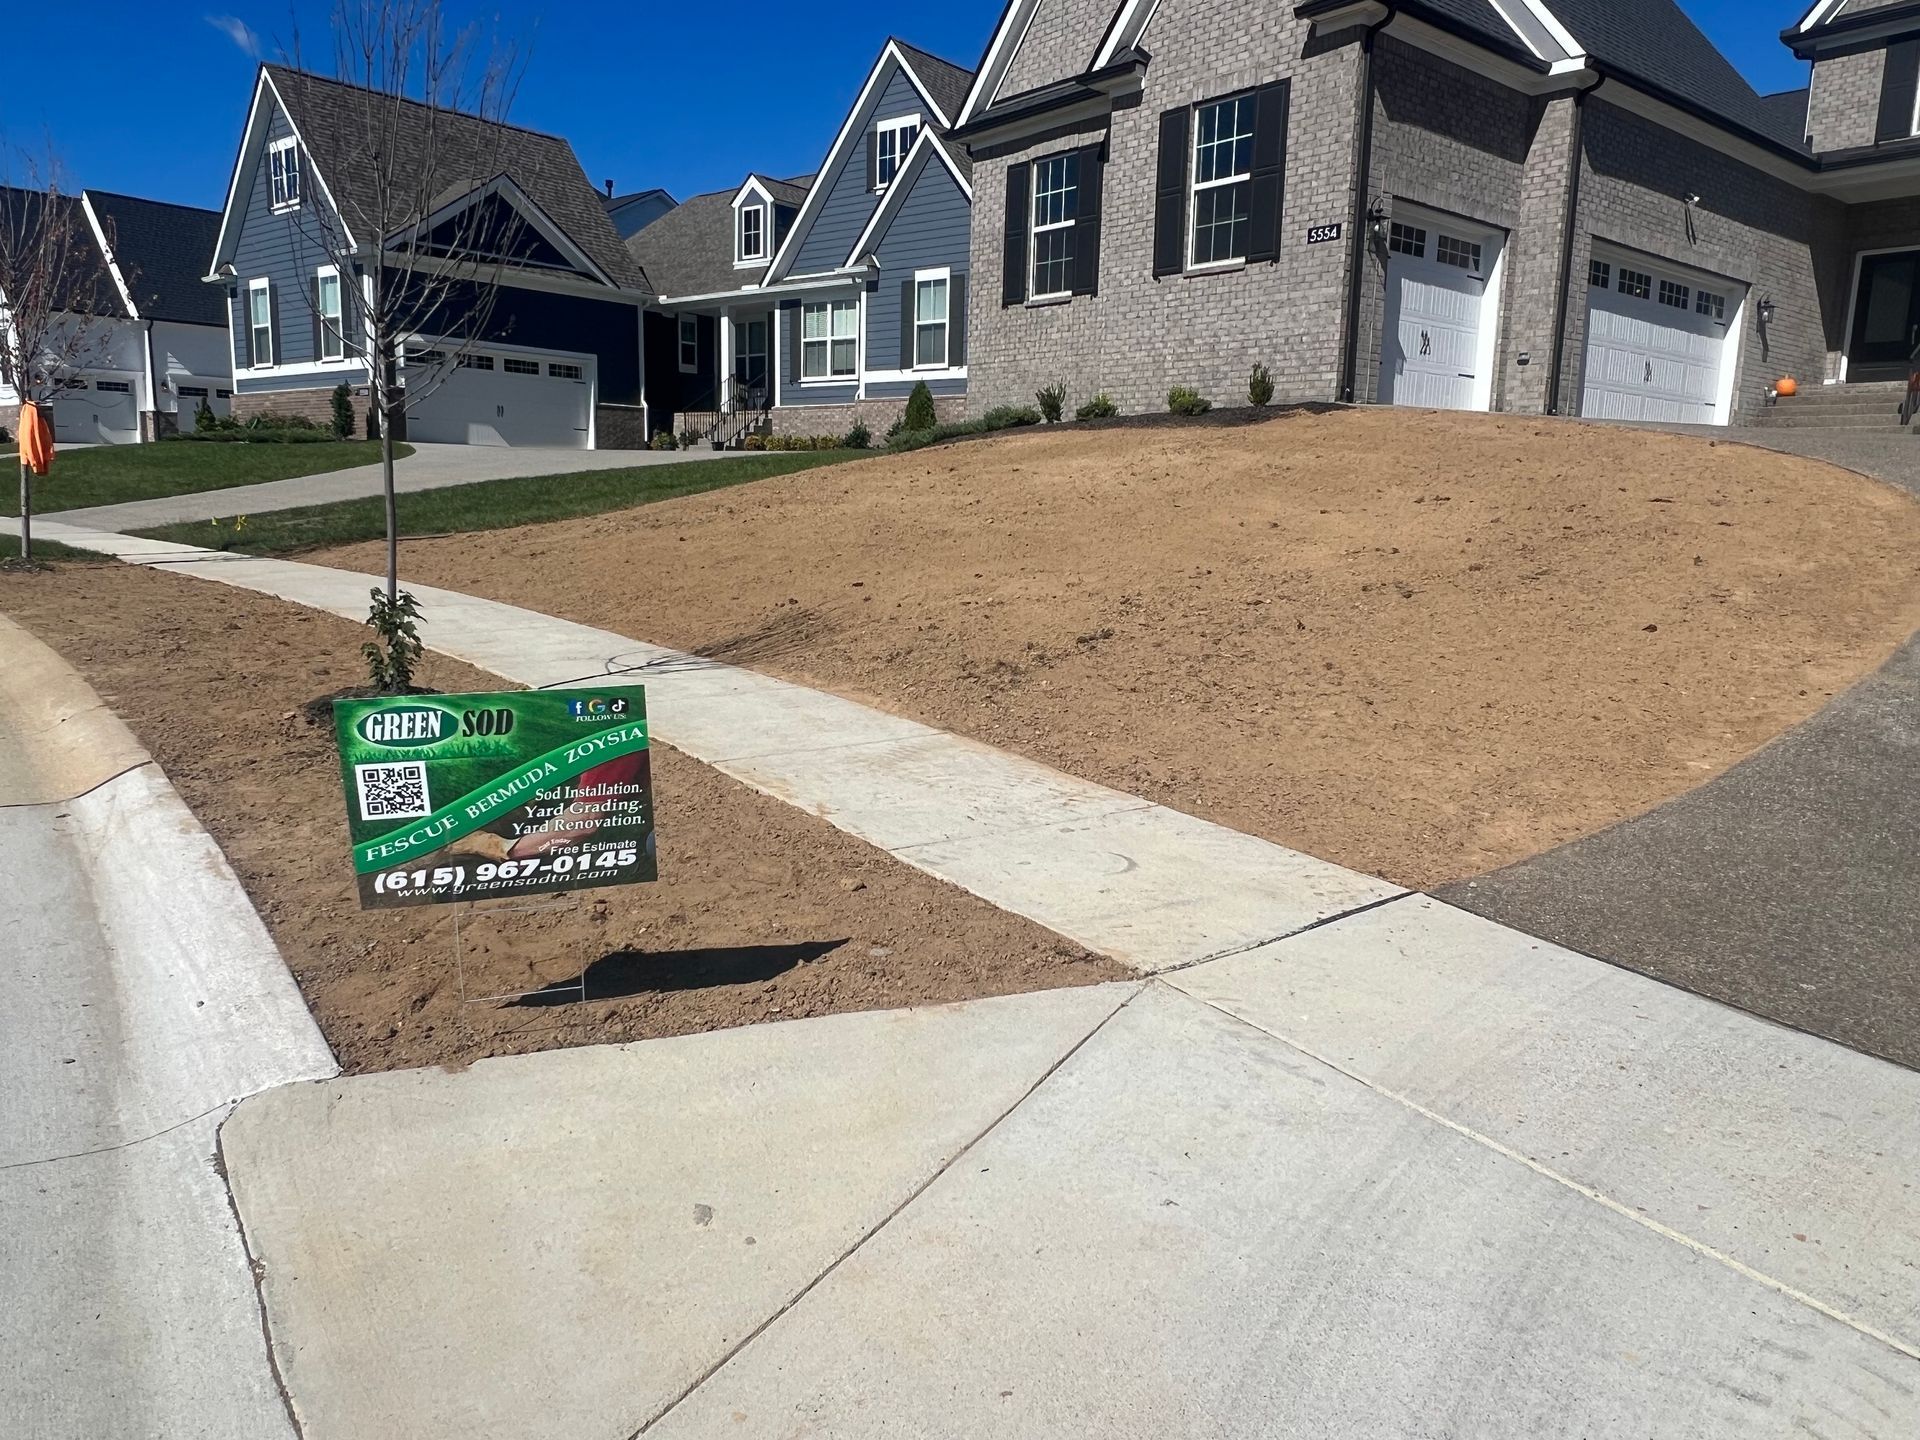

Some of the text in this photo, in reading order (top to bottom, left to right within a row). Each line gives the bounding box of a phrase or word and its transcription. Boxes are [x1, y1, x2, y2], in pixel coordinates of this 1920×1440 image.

[1310, 226, 1337, 242] 5554
[365, 708, 514, 742] GREEN SOD
[575, 714, 612, 723] FOLLOW
[365, 727, 644, 862] FESCUE BERMUDA ZOYSIA
[535, 781, 643, 802] Sod Installation.
[524, 798, 643, 819] Yard Grading.
[512, 813, 646, 836] Yard Renovation.
[550, 839, 637, 856] Free Estimate
[374, 848, 638, 894] (615) 967-0145
[397, 869, 619, 897] www.greensodtn.com
